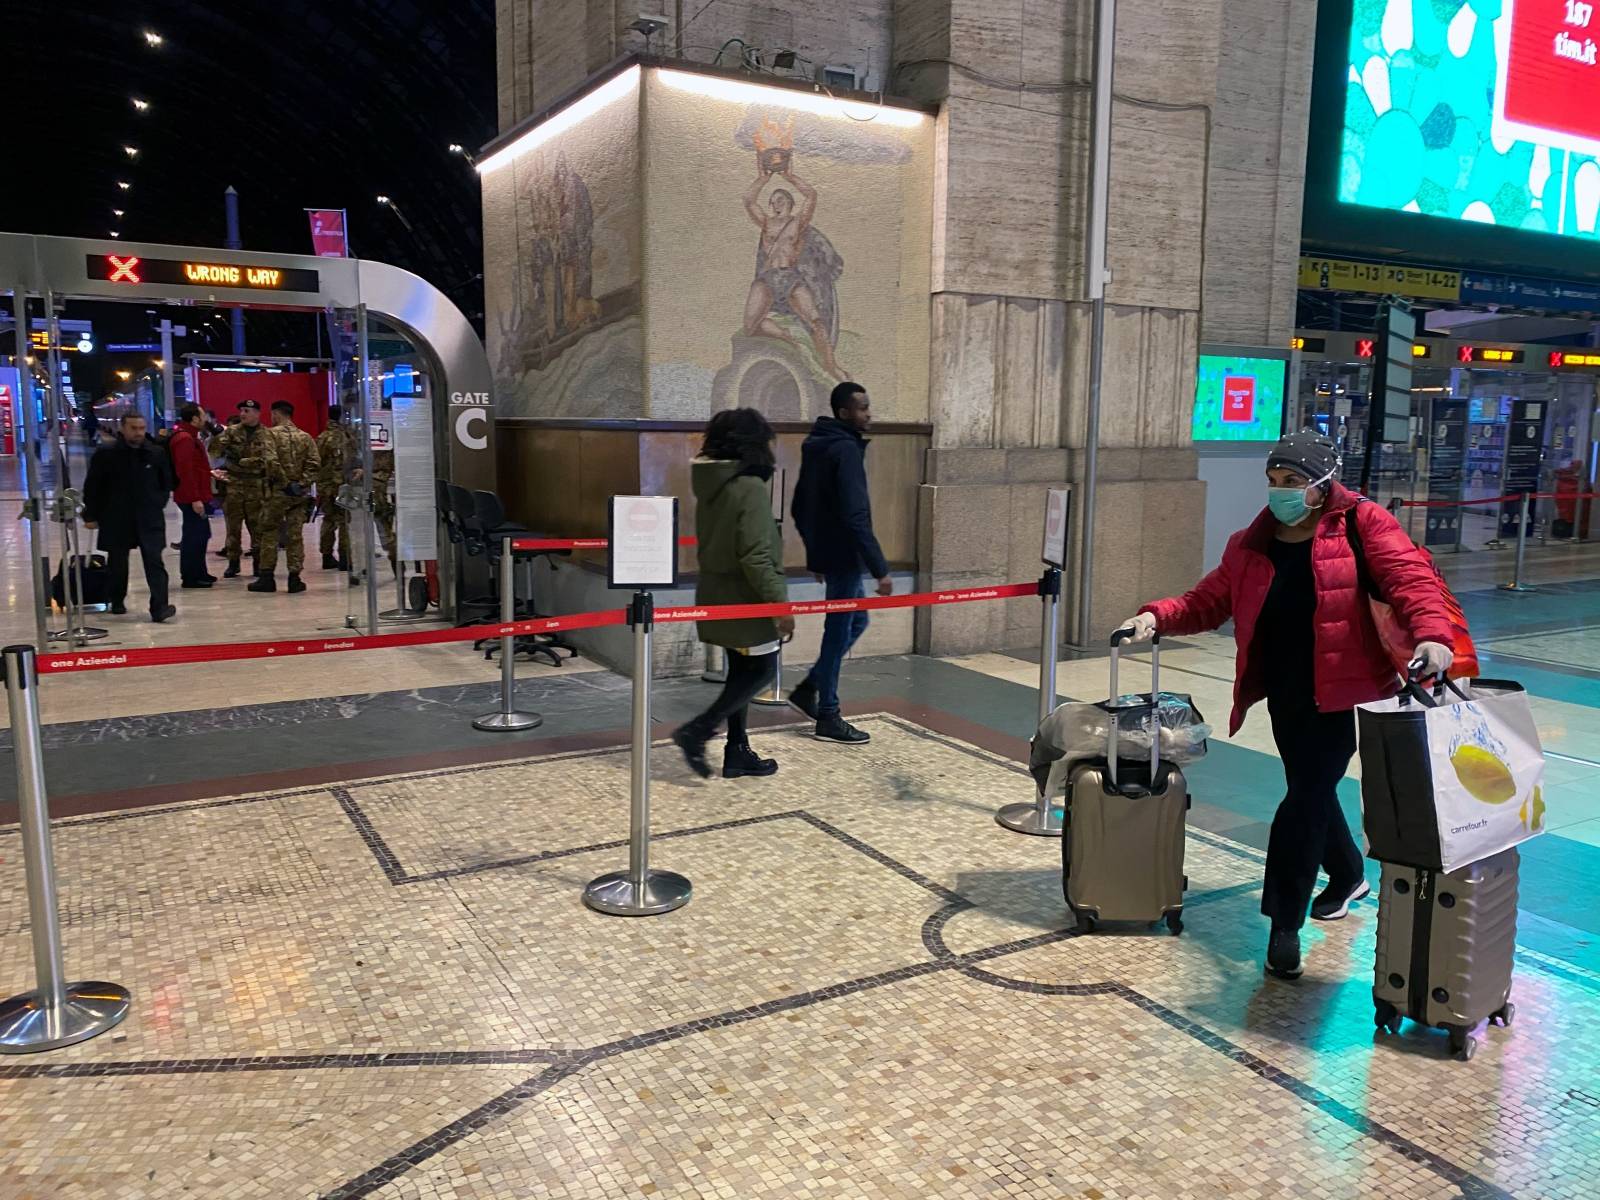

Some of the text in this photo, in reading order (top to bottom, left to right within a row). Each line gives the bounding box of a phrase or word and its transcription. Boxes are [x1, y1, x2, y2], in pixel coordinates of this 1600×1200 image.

[186, 264, 279, 285] WRONG WAY
[1353, 265, 1379, 281] 1-13
[1425, 272, 1456, 288] 14-22
[451, 391, 489, 404] GATE
[455, 407, 487, 449] C
